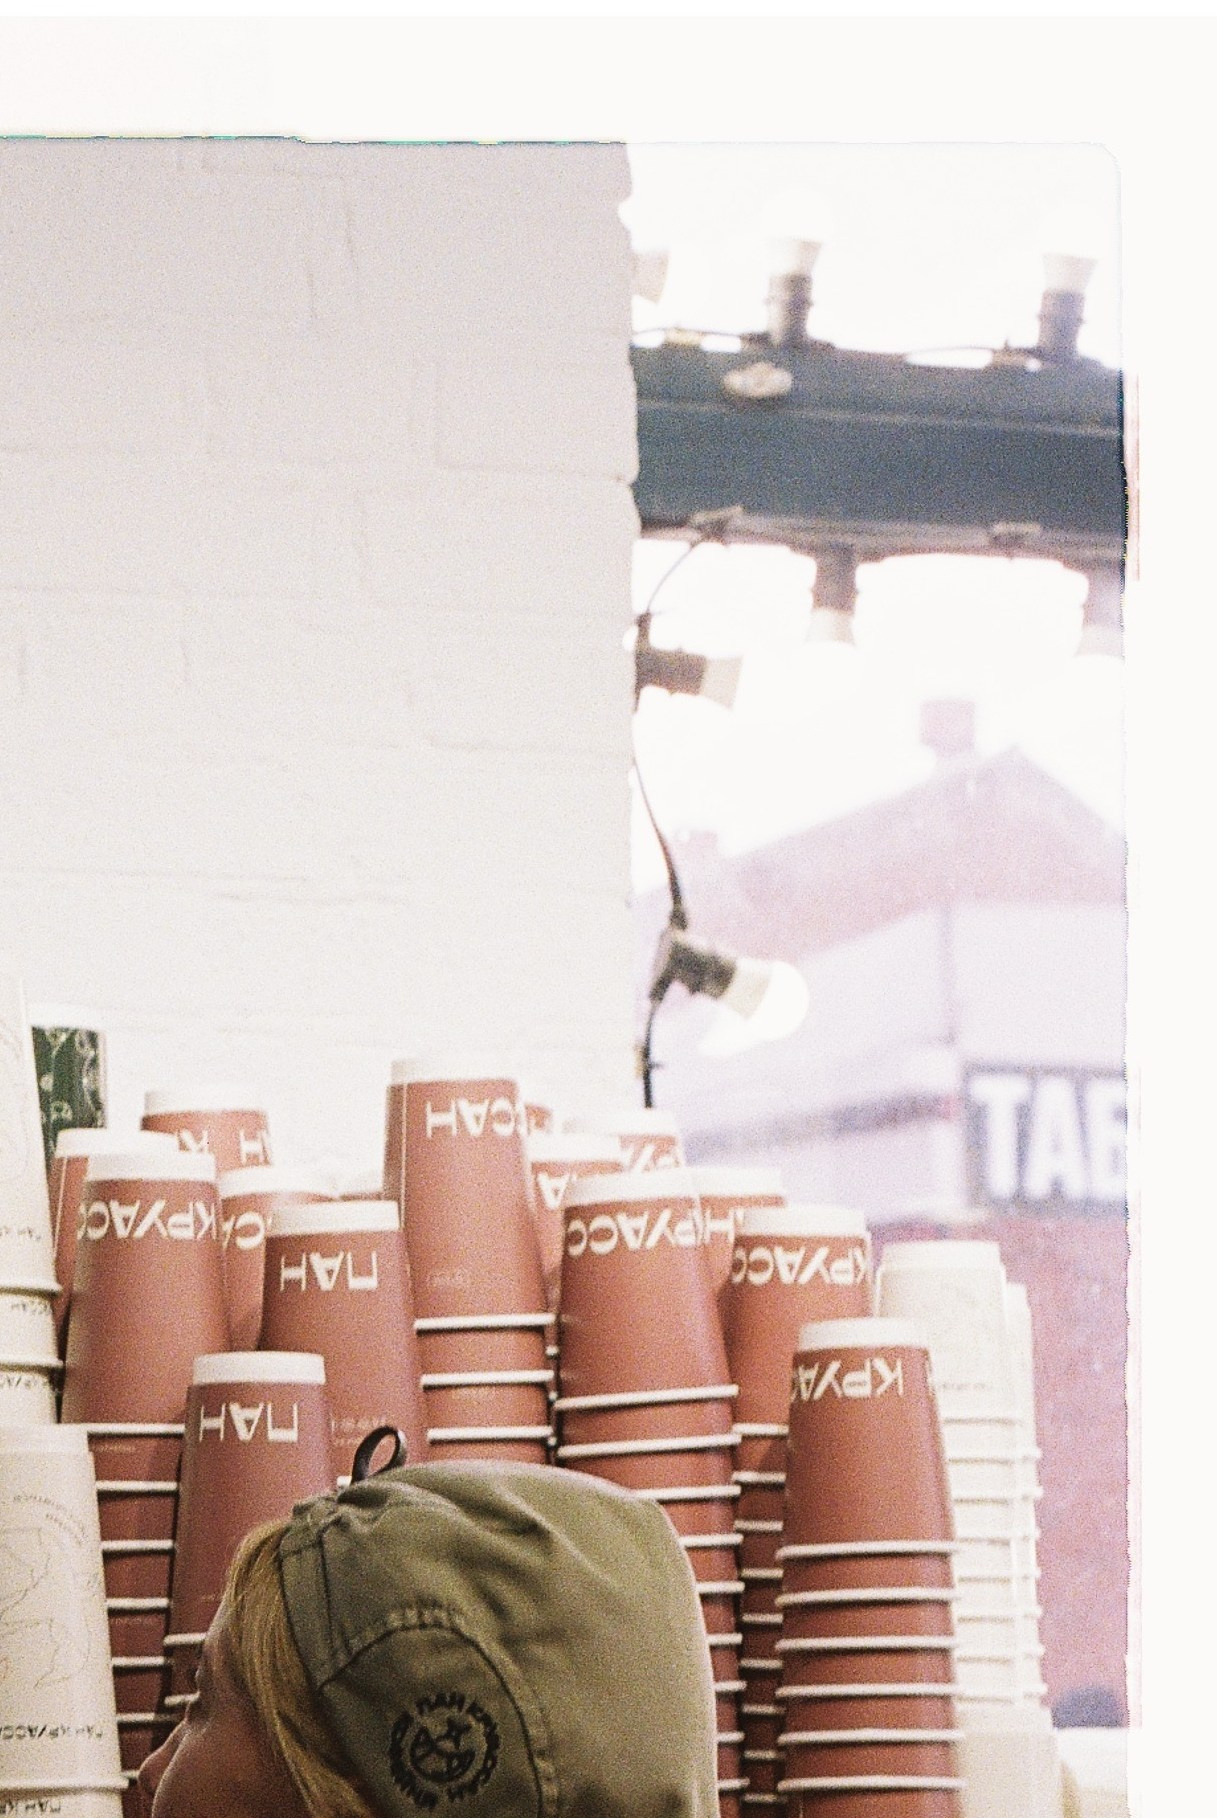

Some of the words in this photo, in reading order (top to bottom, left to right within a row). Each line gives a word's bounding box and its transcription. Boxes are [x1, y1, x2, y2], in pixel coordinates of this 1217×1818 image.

[425, 1096, 525, 1138] САН
[280, 1250, 380, 1293] ПАН
[199, 1402, 299, 1443] ПАН
